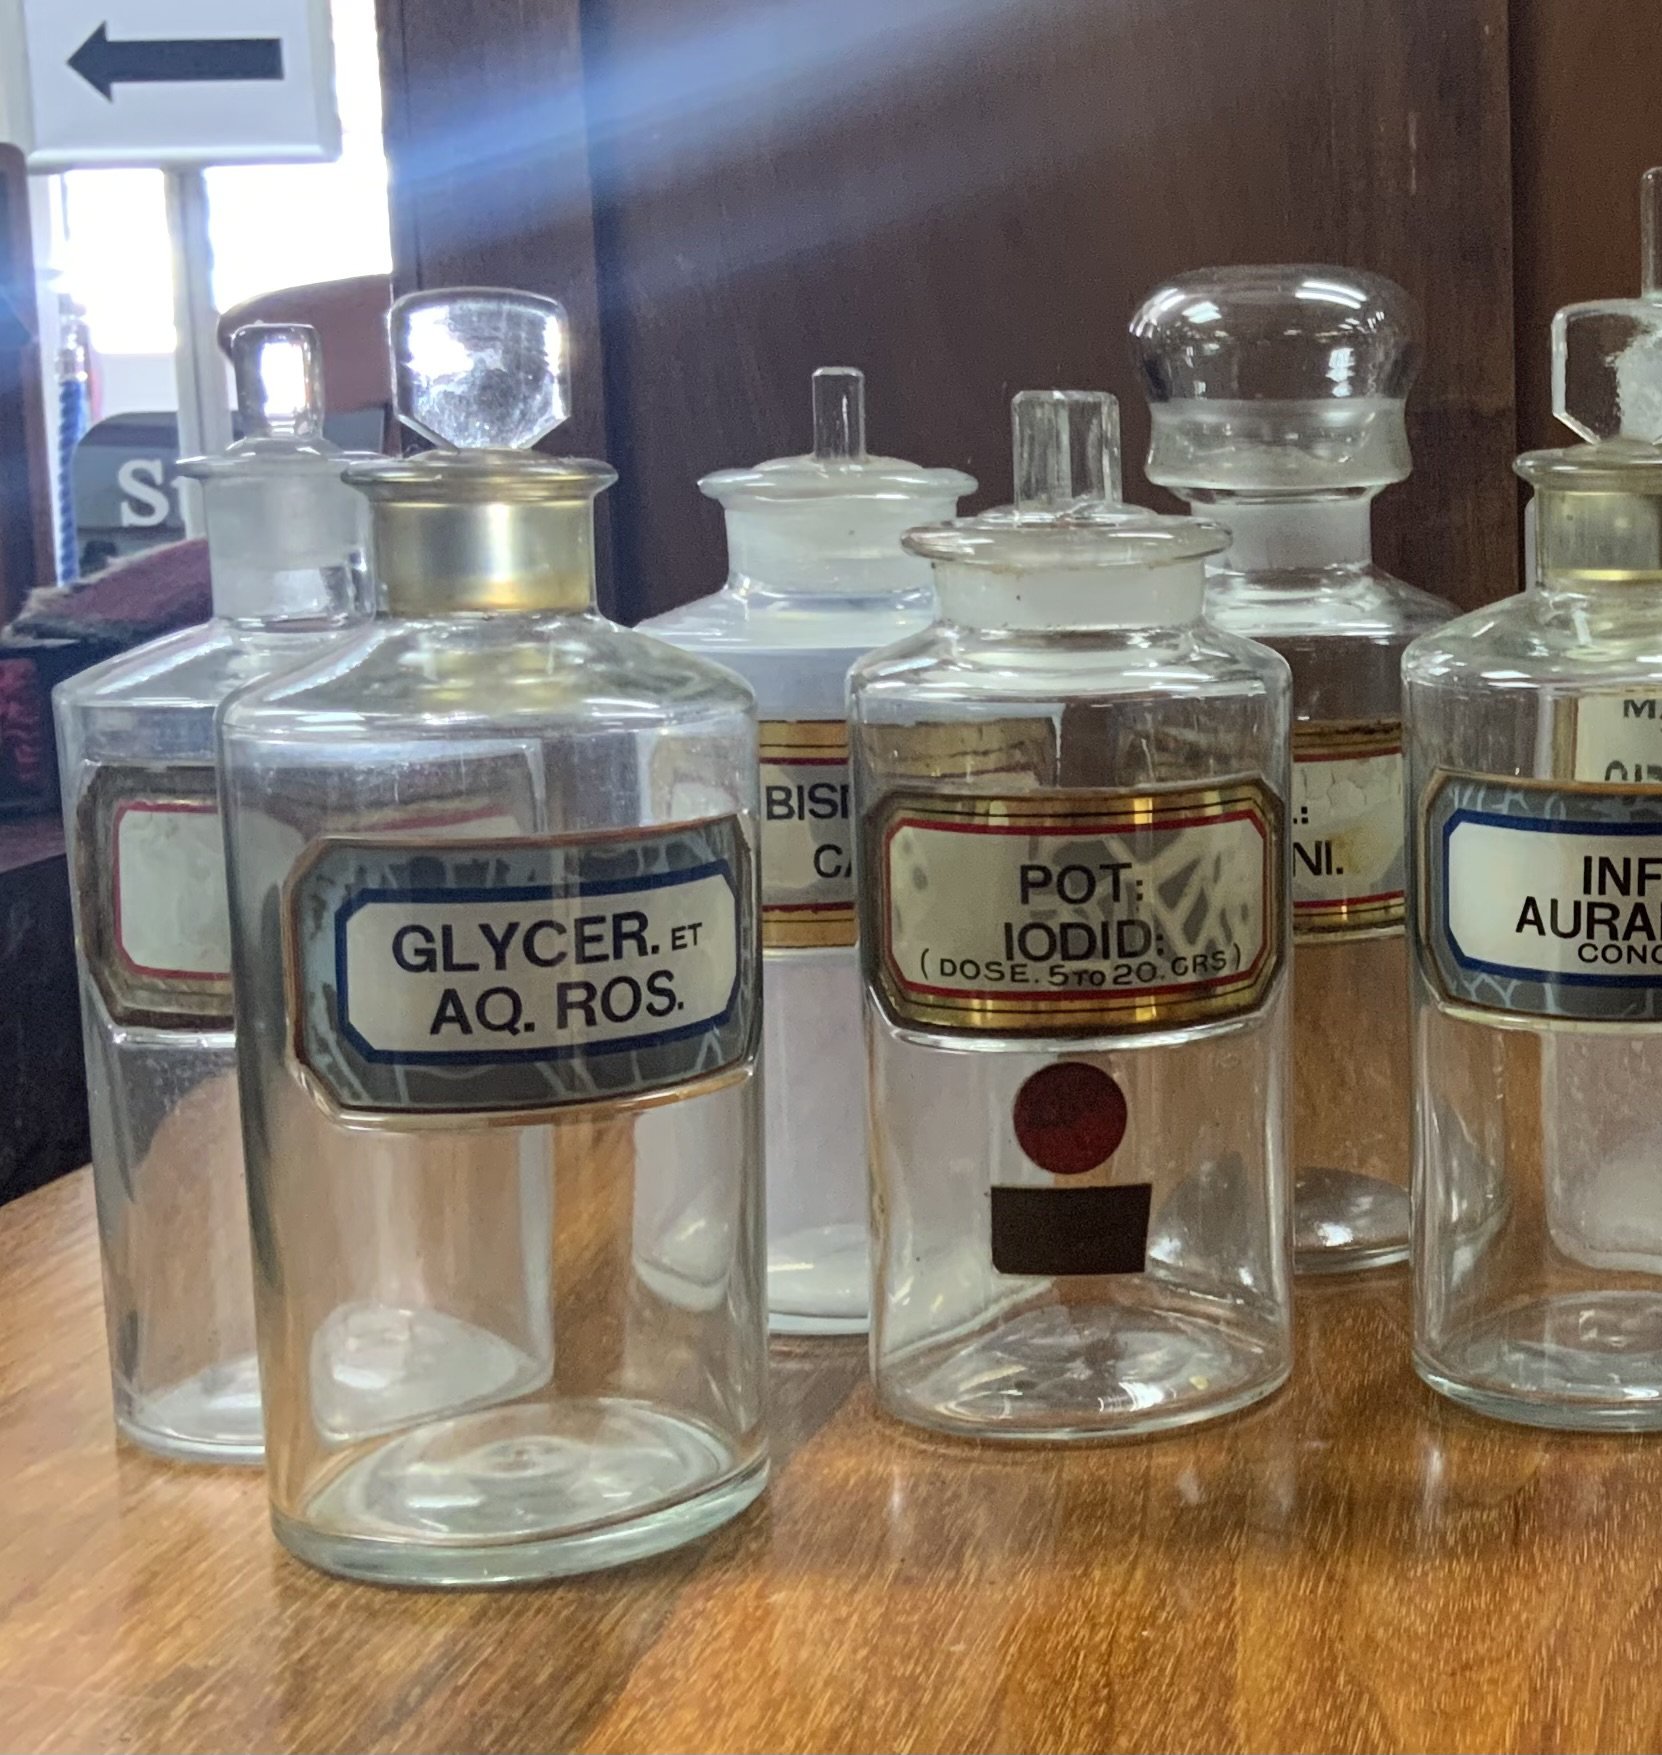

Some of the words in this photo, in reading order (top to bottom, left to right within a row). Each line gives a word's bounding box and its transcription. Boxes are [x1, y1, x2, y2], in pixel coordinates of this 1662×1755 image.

[765, 782, 850, 821] BIS
[1019, 862, 1143, 905] POT:
[391, 910, 660, 974] GLYCER.
[670, 922, 704, 951] ET
[1003, 919, 1164, 962] IODID:
[429, 986, 536, 1037] AQ.
[556, 969, 685, 1030] ROS.
